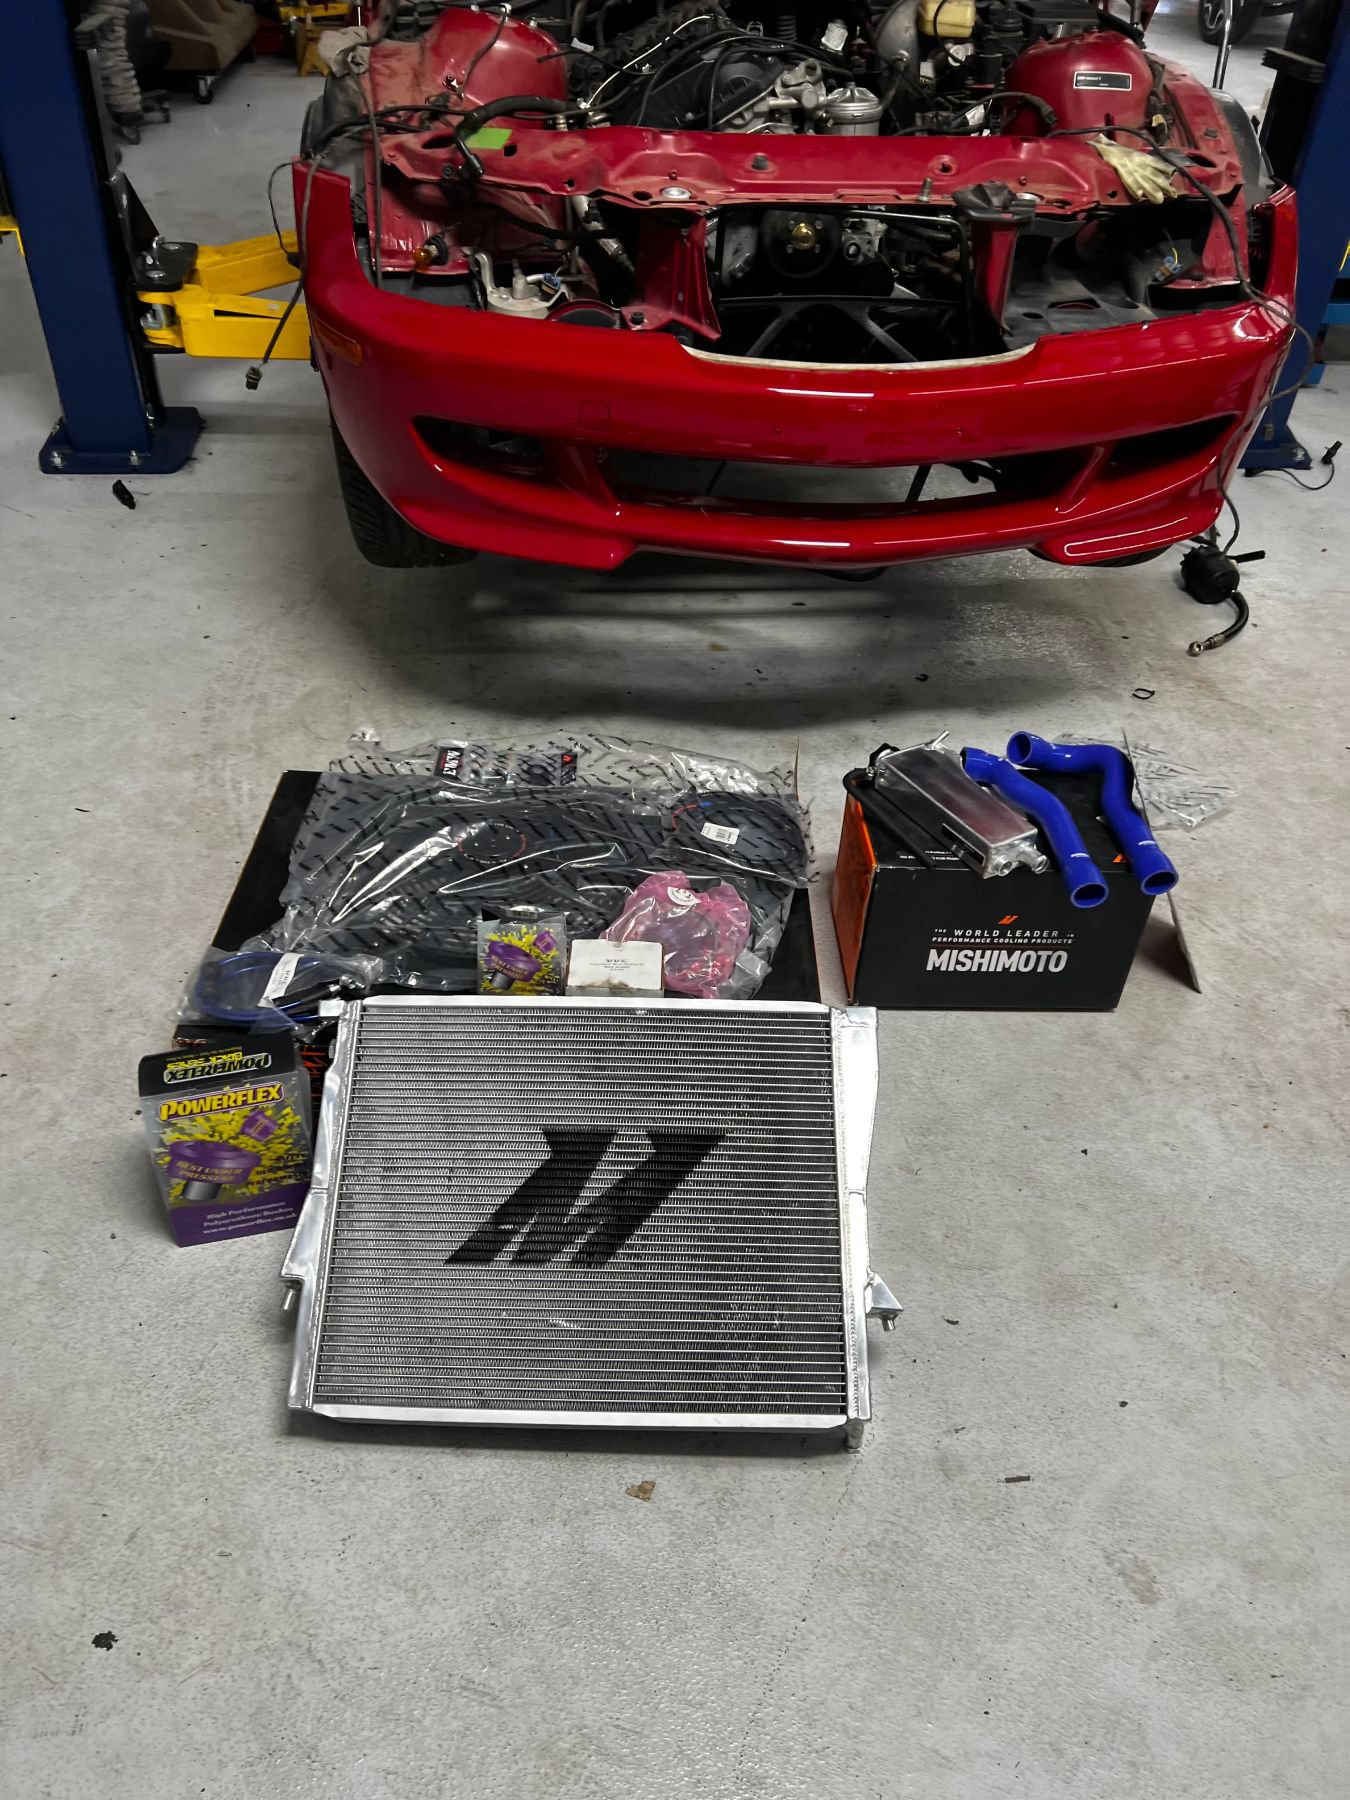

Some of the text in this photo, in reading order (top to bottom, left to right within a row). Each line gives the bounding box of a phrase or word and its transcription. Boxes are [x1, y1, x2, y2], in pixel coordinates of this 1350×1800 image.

[954, 929, 1000, 937] WORLD
[1007, 930, 1059, 938] LEADER
[926, 948, 1068, 973] MISHIMOTO
[167, 1055, 269, 1082] POWERFLEX
[160, 1083, 281, 1121] POWERFLEX
